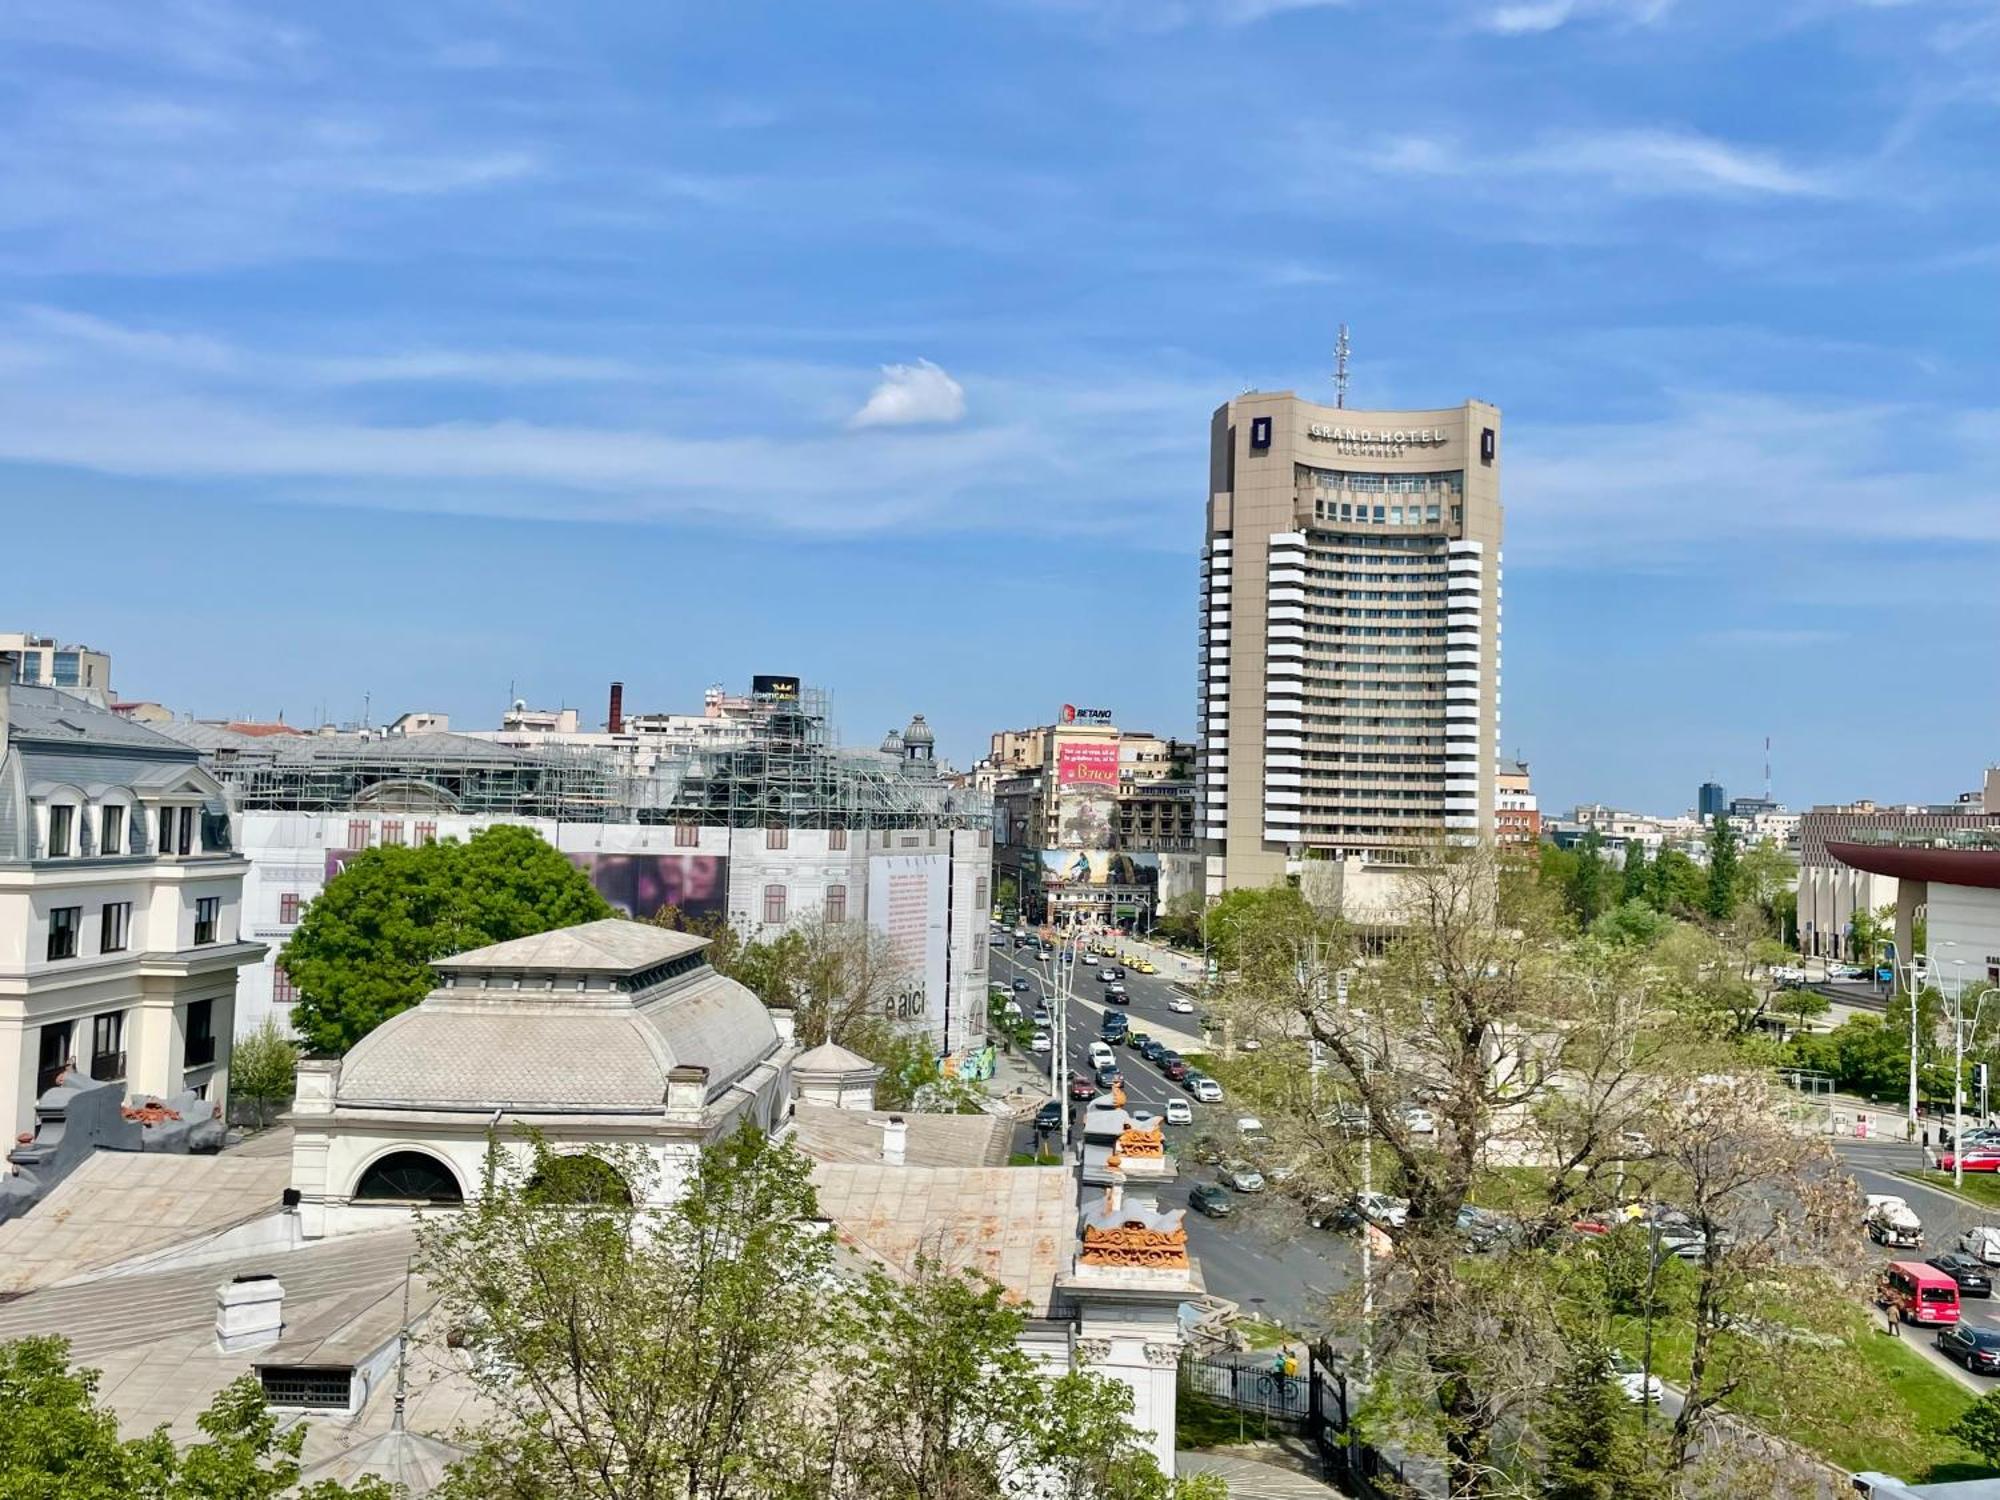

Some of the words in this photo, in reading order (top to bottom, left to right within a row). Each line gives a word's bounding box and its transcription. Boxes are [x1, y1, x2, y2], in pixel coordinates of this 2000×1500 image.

[1311, 424, 1372, 442] GRAND
[1380, 429, 1443, 442] HOTEL
[1337, 442, 1407, 454] BUCHAREST
[1077, 709, 1112, 718] BETANO
[898, 981, 926, 1019] aici
